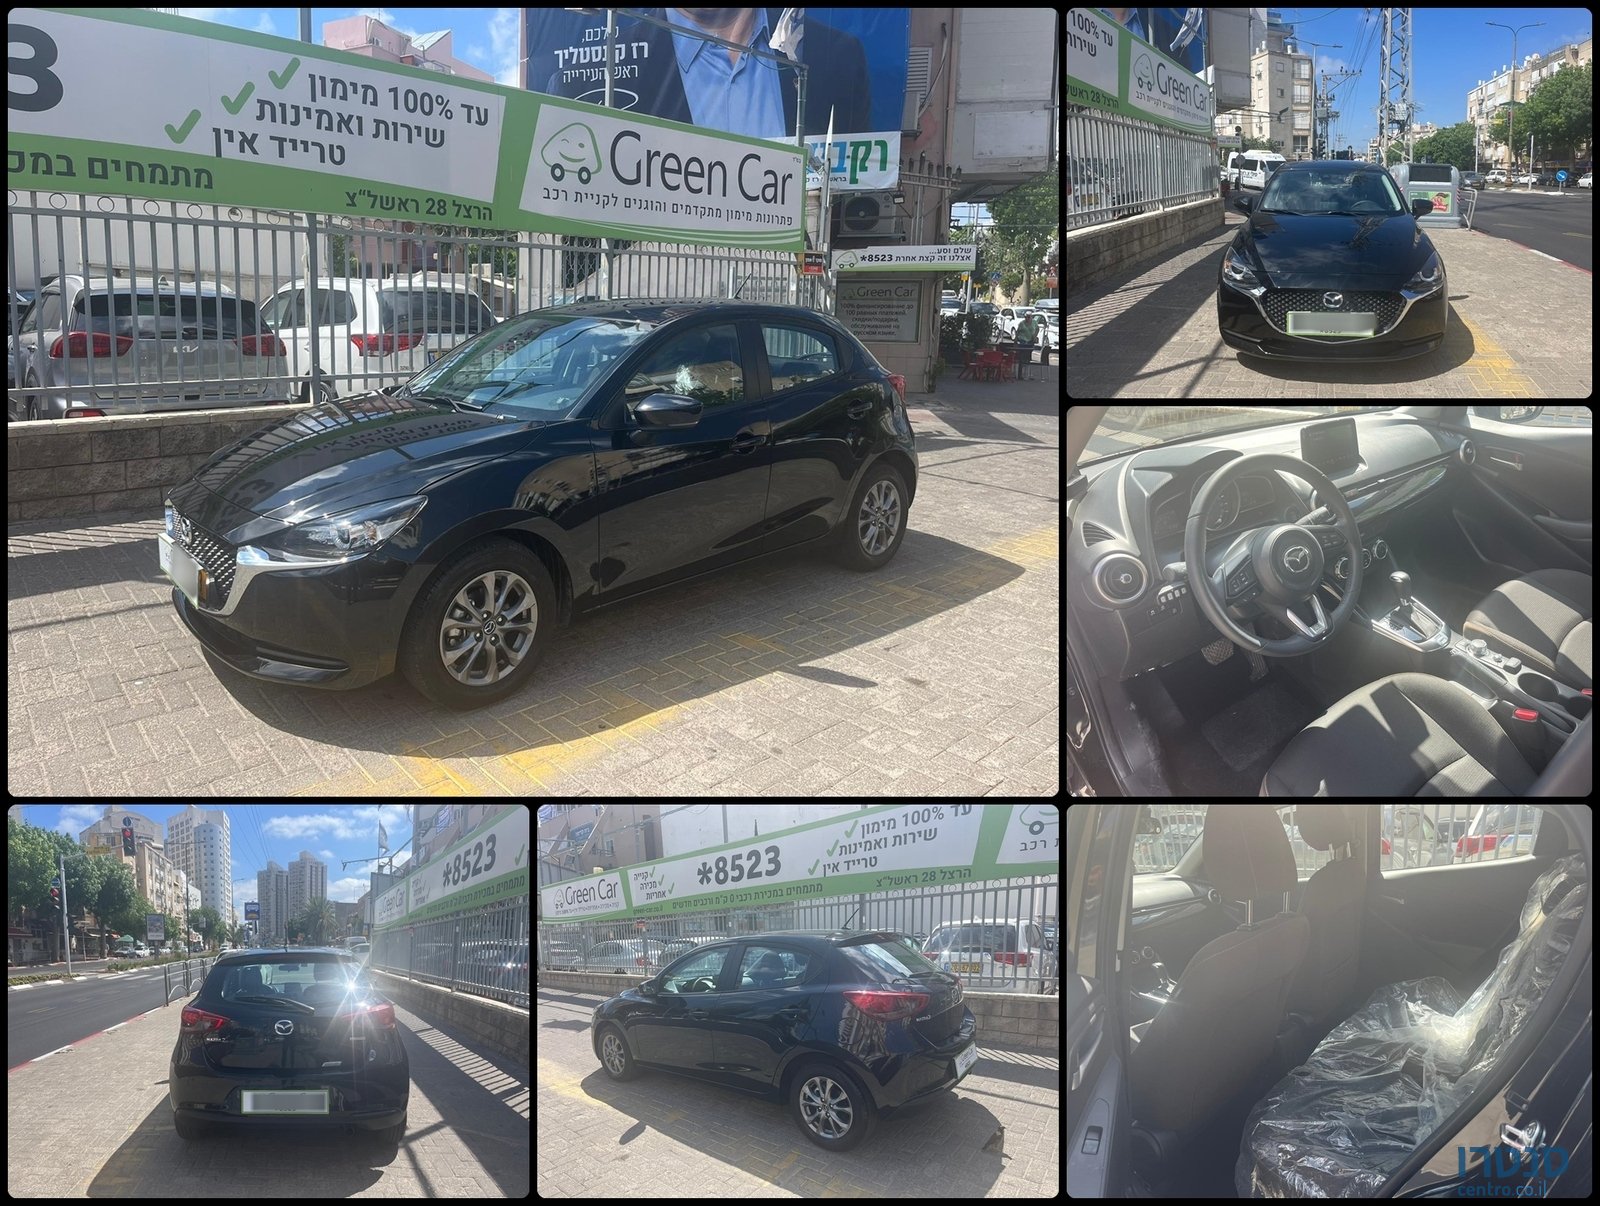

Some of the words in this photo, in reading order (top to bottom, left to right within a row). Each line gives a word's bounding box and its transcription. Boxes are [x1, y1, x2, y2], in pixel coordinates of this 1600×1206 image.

[1070, 10, 1099, 39] 100%
[1101, 29, 1113, 47] עד
[631, 42, 649, 59] רז
[308, 73, 378, 107] מימון
[1090, 90, 1100, 103] 28
[1157, 62, 1192, 107] Green
[1193, 83, 1208, 113] Car
[388, 87, 454, 121] 100%
[1102, 92, 1119, 109] הרצל
[256, 99, 363, 136] ואמינות
[460, 103, 489, 126] עד
[212, 127, 260, 158] אין
[372, 119, 445, 148] שירות
[269, 135, 346, 165] טרייד
[88, 157, 214, 189] מתמחים
[609, 130, 728, 198] Green
[737, 153, 793, 205] Car
[542, 186, 568, 202] רכב
[573, 191, 618, 209] לקניית
[425, 197, 447, 217] 28
[452, 200, 493, 221] הרצל
[623, 197, 667, 213] והוגנים
[671, 203, 722, 219] מתקדמים
[725, 209, 752, 223] מימון
[755, 211, 793, 227] פתרונות
[918, 255, 936, 263] קצת
[856, 286, 892, 297] Green
[894, 286, 914, 297] Car
[902, 806, 944, 827] 100%
[861, 816, 897, 839] מימון
[892, 827, 938, 848] שירות
[1020, 839, 1047, 852] רכב
[838, 837, 888, 857] ואמינות
[822, 861, 840, 877] אין
[843, 856, 878, 873] טרייד
[940, 867, 972, 880] הרצל
[921, 871, 937, 883] 28
[565, 886, 596, 906] Green
[597, 878, 618, 900] Car
[646, 890, 667, 901] אחריות
[753, 890, 784, 901] במכירת
[786, 882, 823, 896] מתמחים
